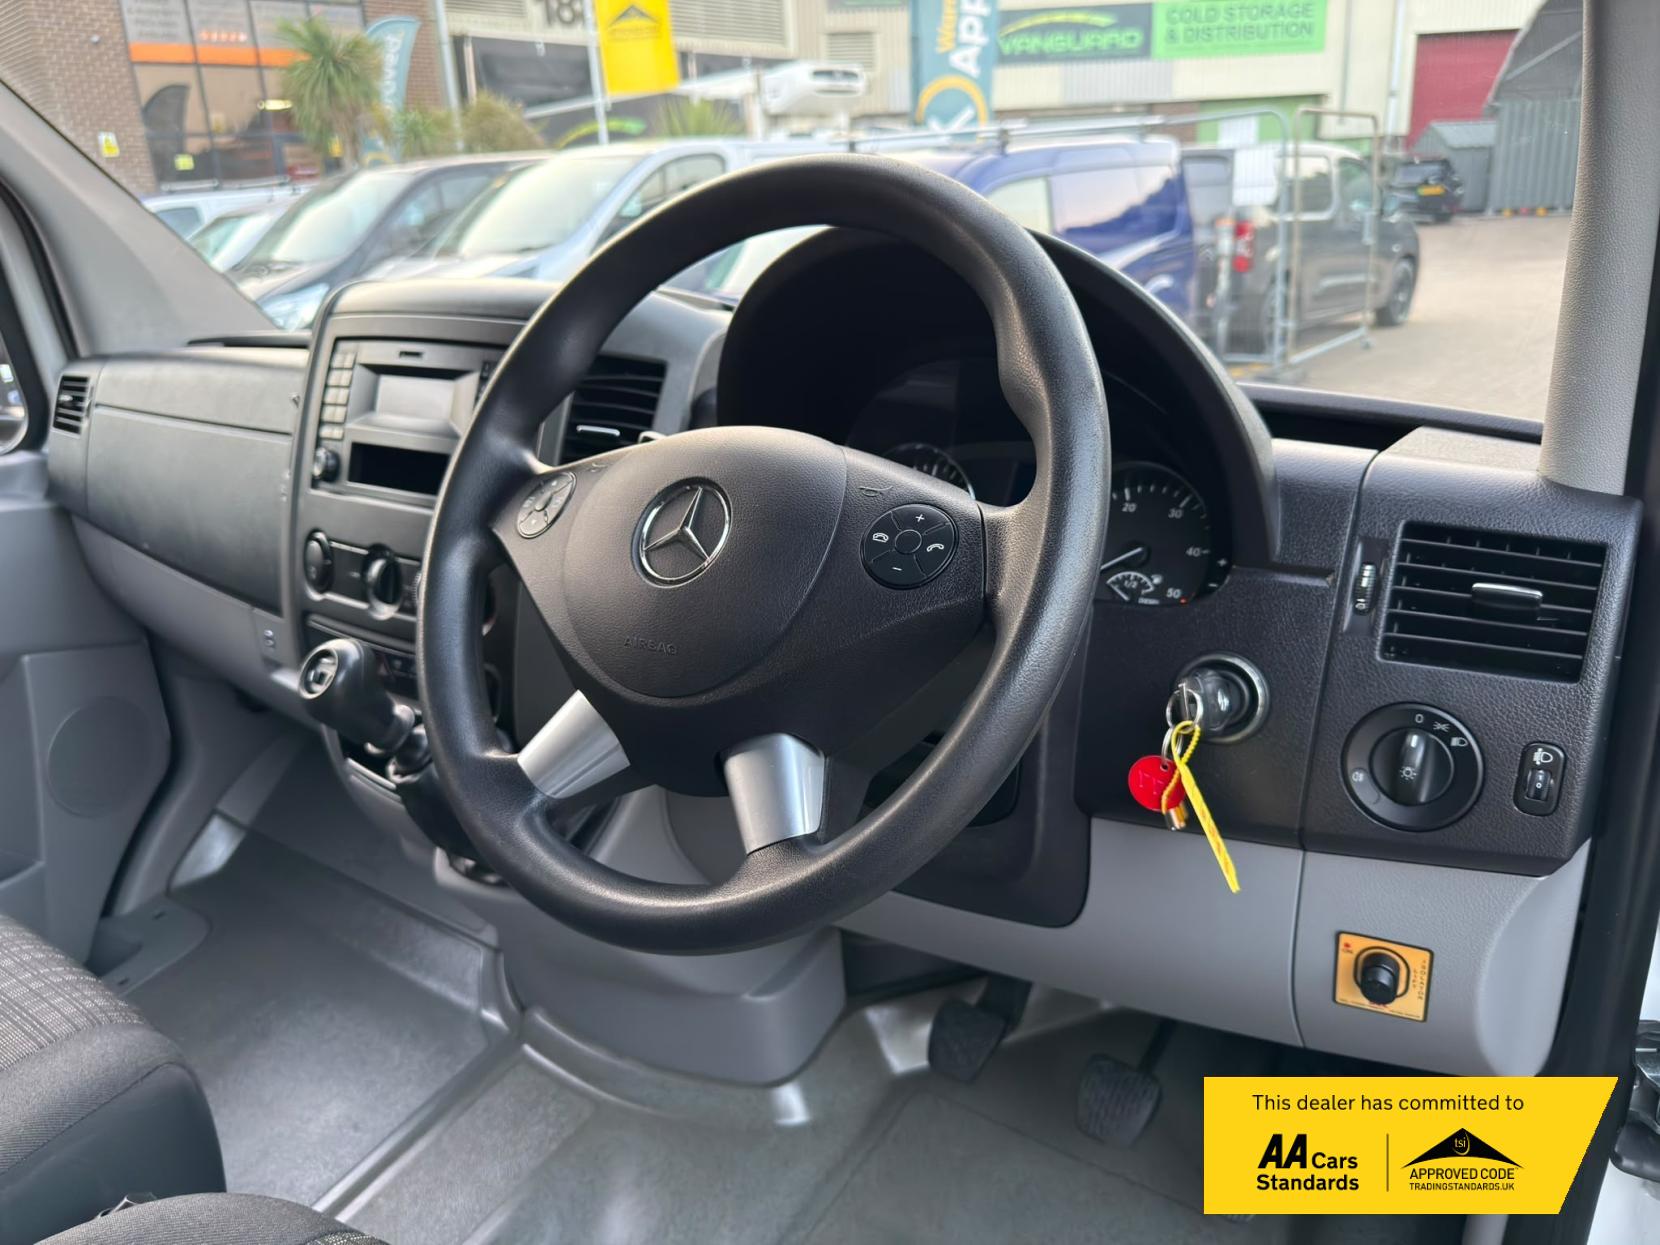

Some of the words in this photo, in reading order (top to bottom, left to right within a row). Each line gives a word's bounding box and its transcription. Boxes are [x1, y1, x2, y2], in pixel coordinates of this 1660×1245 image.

[1166, 7, 1219, 25] COLD
[1223, 2, 1313, 22] STORAGE
[1166, 28, 1179, 43] &
[1184, 21, 1312, 42] DISTRIBUTION
[999, 28, 1143, 55] VANGUARD
[1122, 502, 1136, 512] 20
[1168, 508, 1183, 519] 30
[1186, 547, 1201, 557] 40
[1166, 587, 1181, 598] 50
